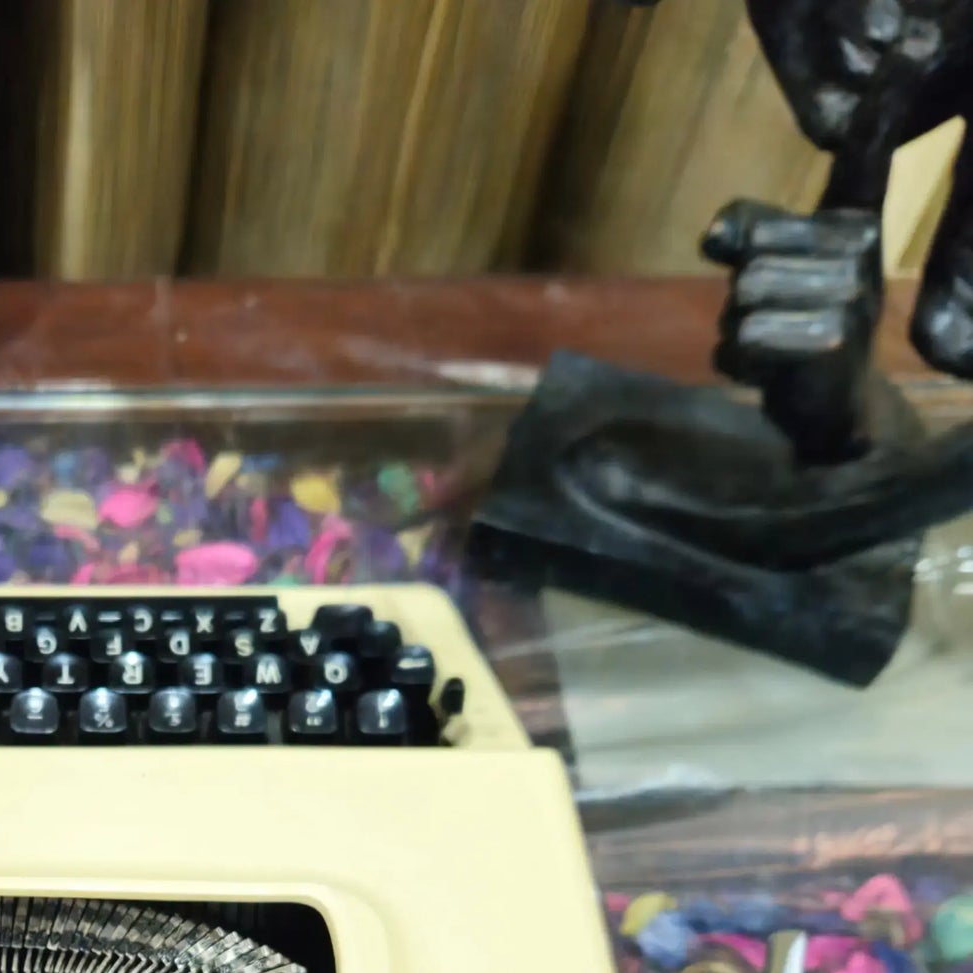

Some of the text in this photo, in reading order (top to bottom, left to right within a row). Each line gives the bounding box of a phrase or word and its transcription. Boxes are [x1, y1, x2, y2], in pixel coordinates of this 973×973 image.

[5, 611, 23, 632] B
[69, 610, 87, 632] V
[133, 609, 153, 633] C
[196, 610, 214, 633] X
[259, 609, 276, 633] Z
[37, 630, 57, 654] G
[106, 632, 122, 655] F
[169, 631, 190, 655] D
[234, 634, 253, 656] S
[300, 631, 322, 656] A
[57, 662, 74, 684] T
[122, 660, 143, 685] R
[195, 664, 212, 685] E
[256, 663, 282, 684] W
[324, 661, 348, 683] Q
